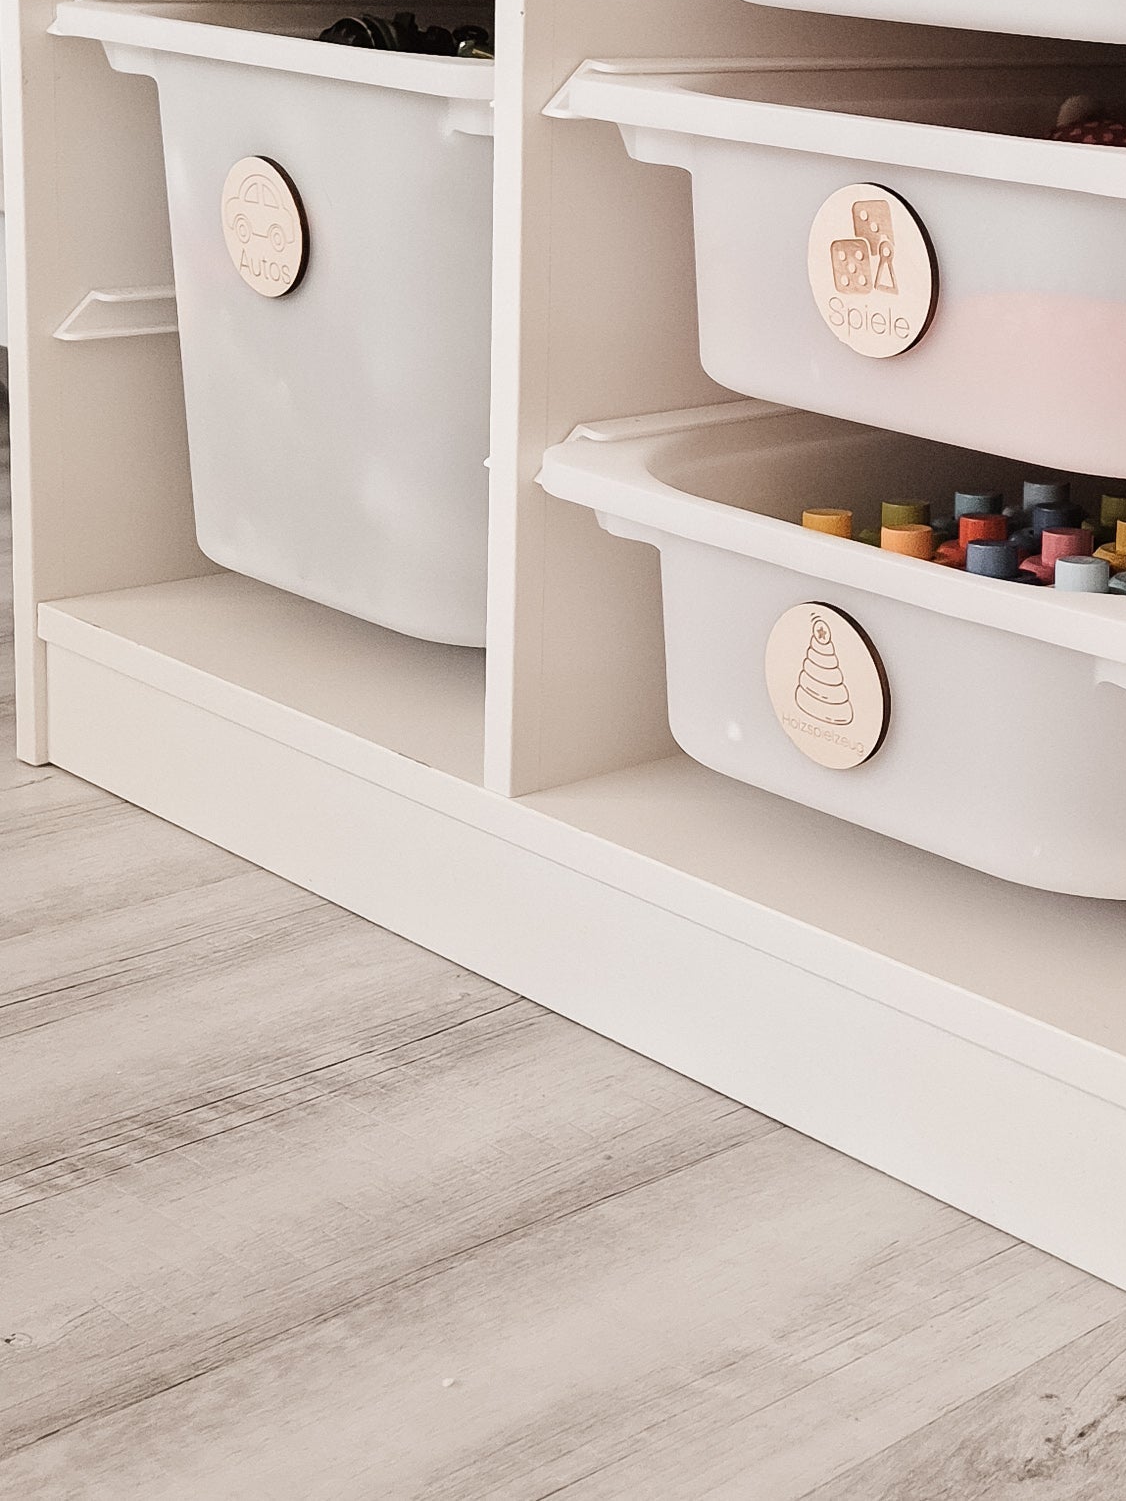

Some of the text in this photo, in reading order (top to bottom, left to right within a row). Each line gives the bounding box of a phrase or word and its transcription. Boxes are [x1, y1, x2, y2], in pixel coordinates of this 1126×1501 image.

[239, 248, 292, 286] Autos
[828, 296, 910, 339] Spiele
[781, 713, 865, 756] Holzspielzeug
